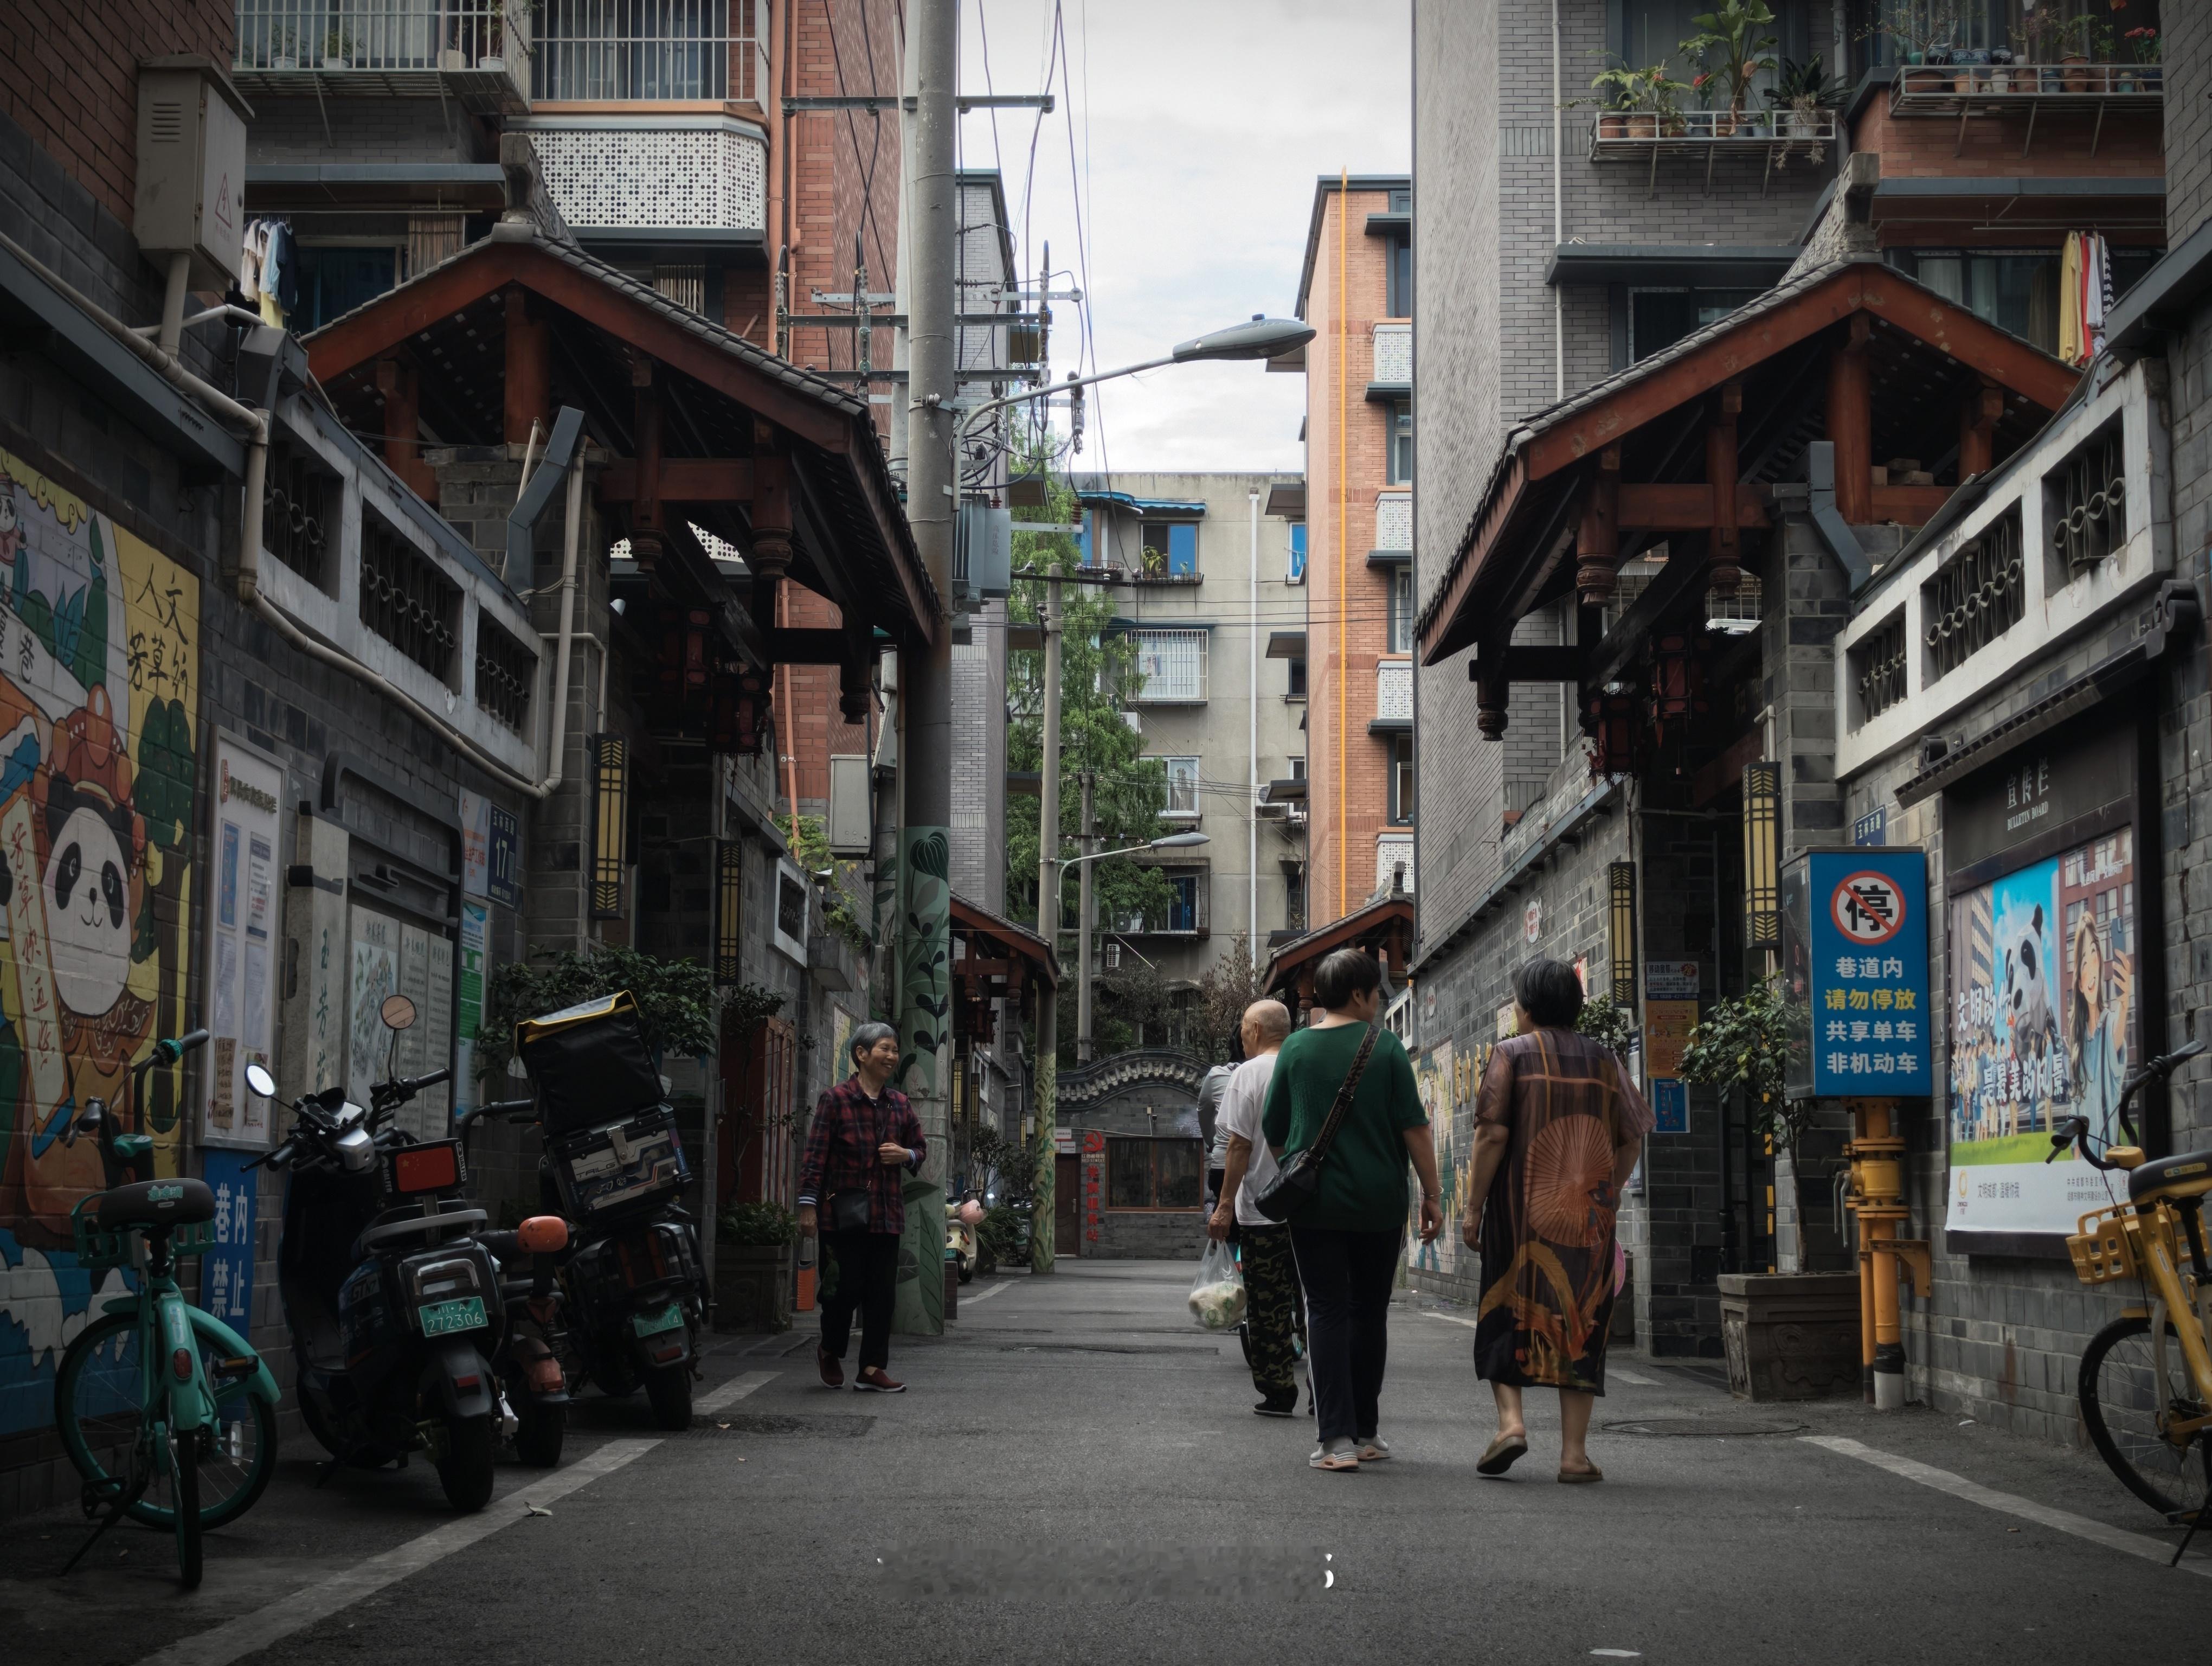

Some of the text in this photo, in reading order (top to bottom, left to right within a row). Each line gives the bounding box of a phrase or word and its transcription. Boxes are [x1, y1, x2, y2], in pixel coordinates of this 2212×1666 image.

[2007, 755, 2049, 809] 宣传栏
[1858, 813, 1880, 840] 玉林西路
[2007, 801, 2048, 831] BULLETIN BOARD
[496, 837, 508, 880] 17
[1844, 885, 1893, 931] 停
[1836, 957, 1903, 978] 巷道内
[1825, 989, 1917, 1010] 请勿停放
[1826, 1020, 1917, 1042] 共享单车
[1827, 1052, 1918, 1074] 非机动车
[1983, 1052, 2063, 1105] 是最美的风景
[576, 1162, 616, 1178] TAILG
[215, 1182, 247, 1246] 巷内
[212, 1258, 245, 1319] 禁止
[427, 1311, 483, 1332] 272306
